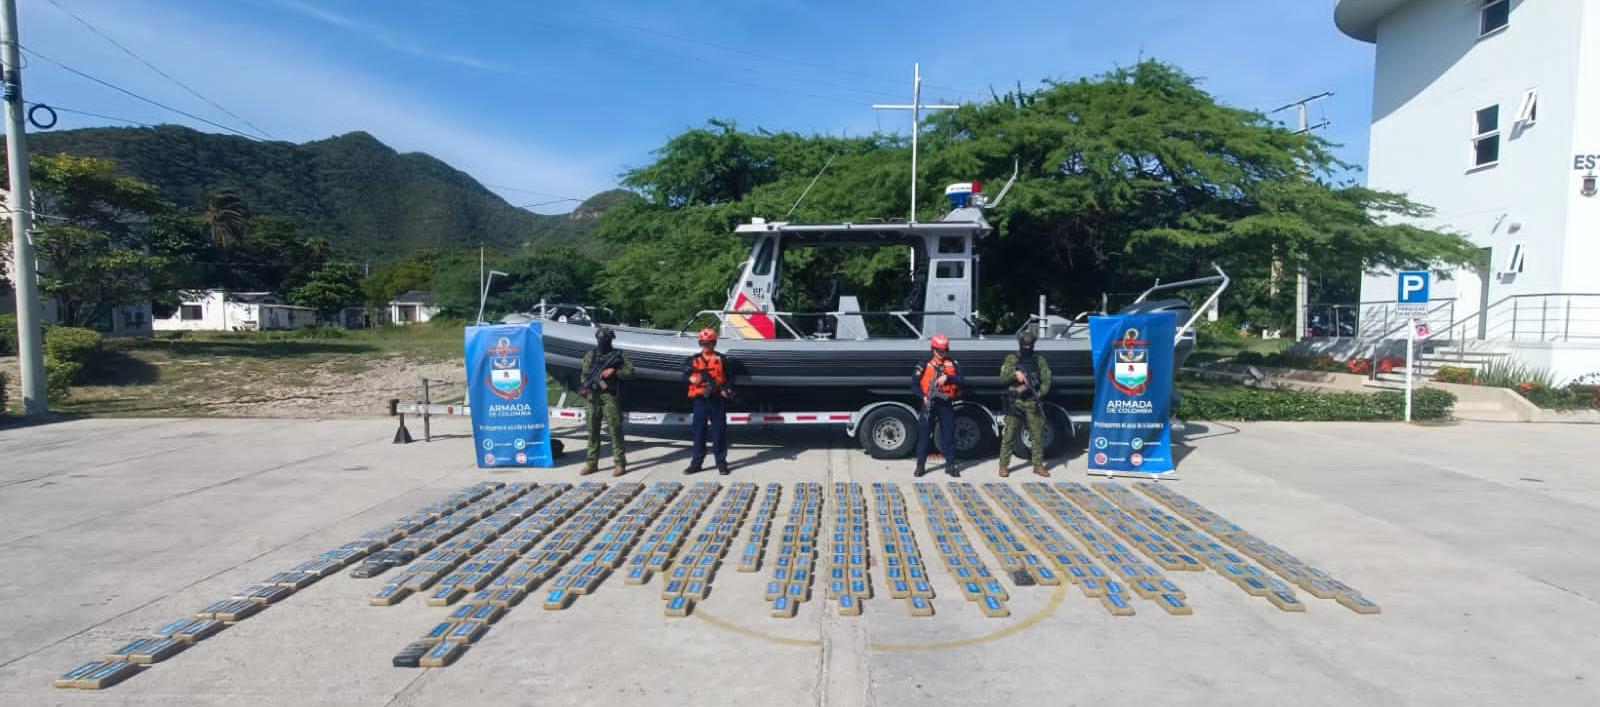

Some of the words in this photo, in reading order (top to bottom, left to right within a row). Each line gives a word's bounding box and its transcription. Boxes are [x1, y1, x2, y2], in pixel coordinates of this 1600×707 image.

[1574, 154, 1600, 170] ES
[1402, 275, 1424, 300] P
[488, 403, 532, 413] ARMADA
[1106, 400, 1153, 409] ARMADA
